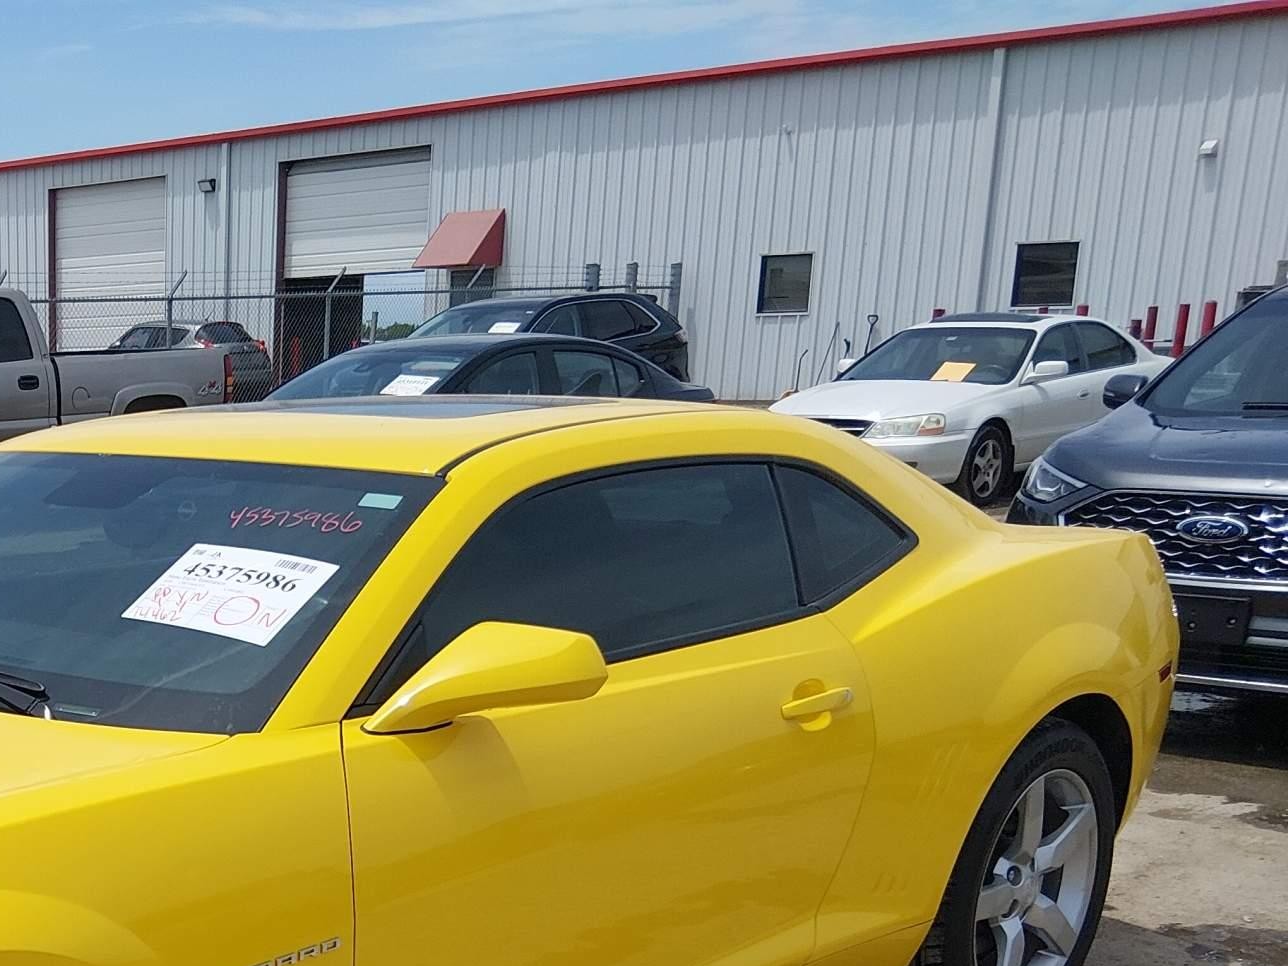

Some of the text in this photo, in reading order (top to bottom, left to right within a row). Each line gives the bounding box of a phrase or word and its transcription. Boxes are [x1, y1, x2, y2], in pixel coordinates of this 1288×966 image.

[230, 506, 363, 533] 45375986
[1192, 521, 1232, 537] Ford
[184, 562, 304, 593] 45375986
